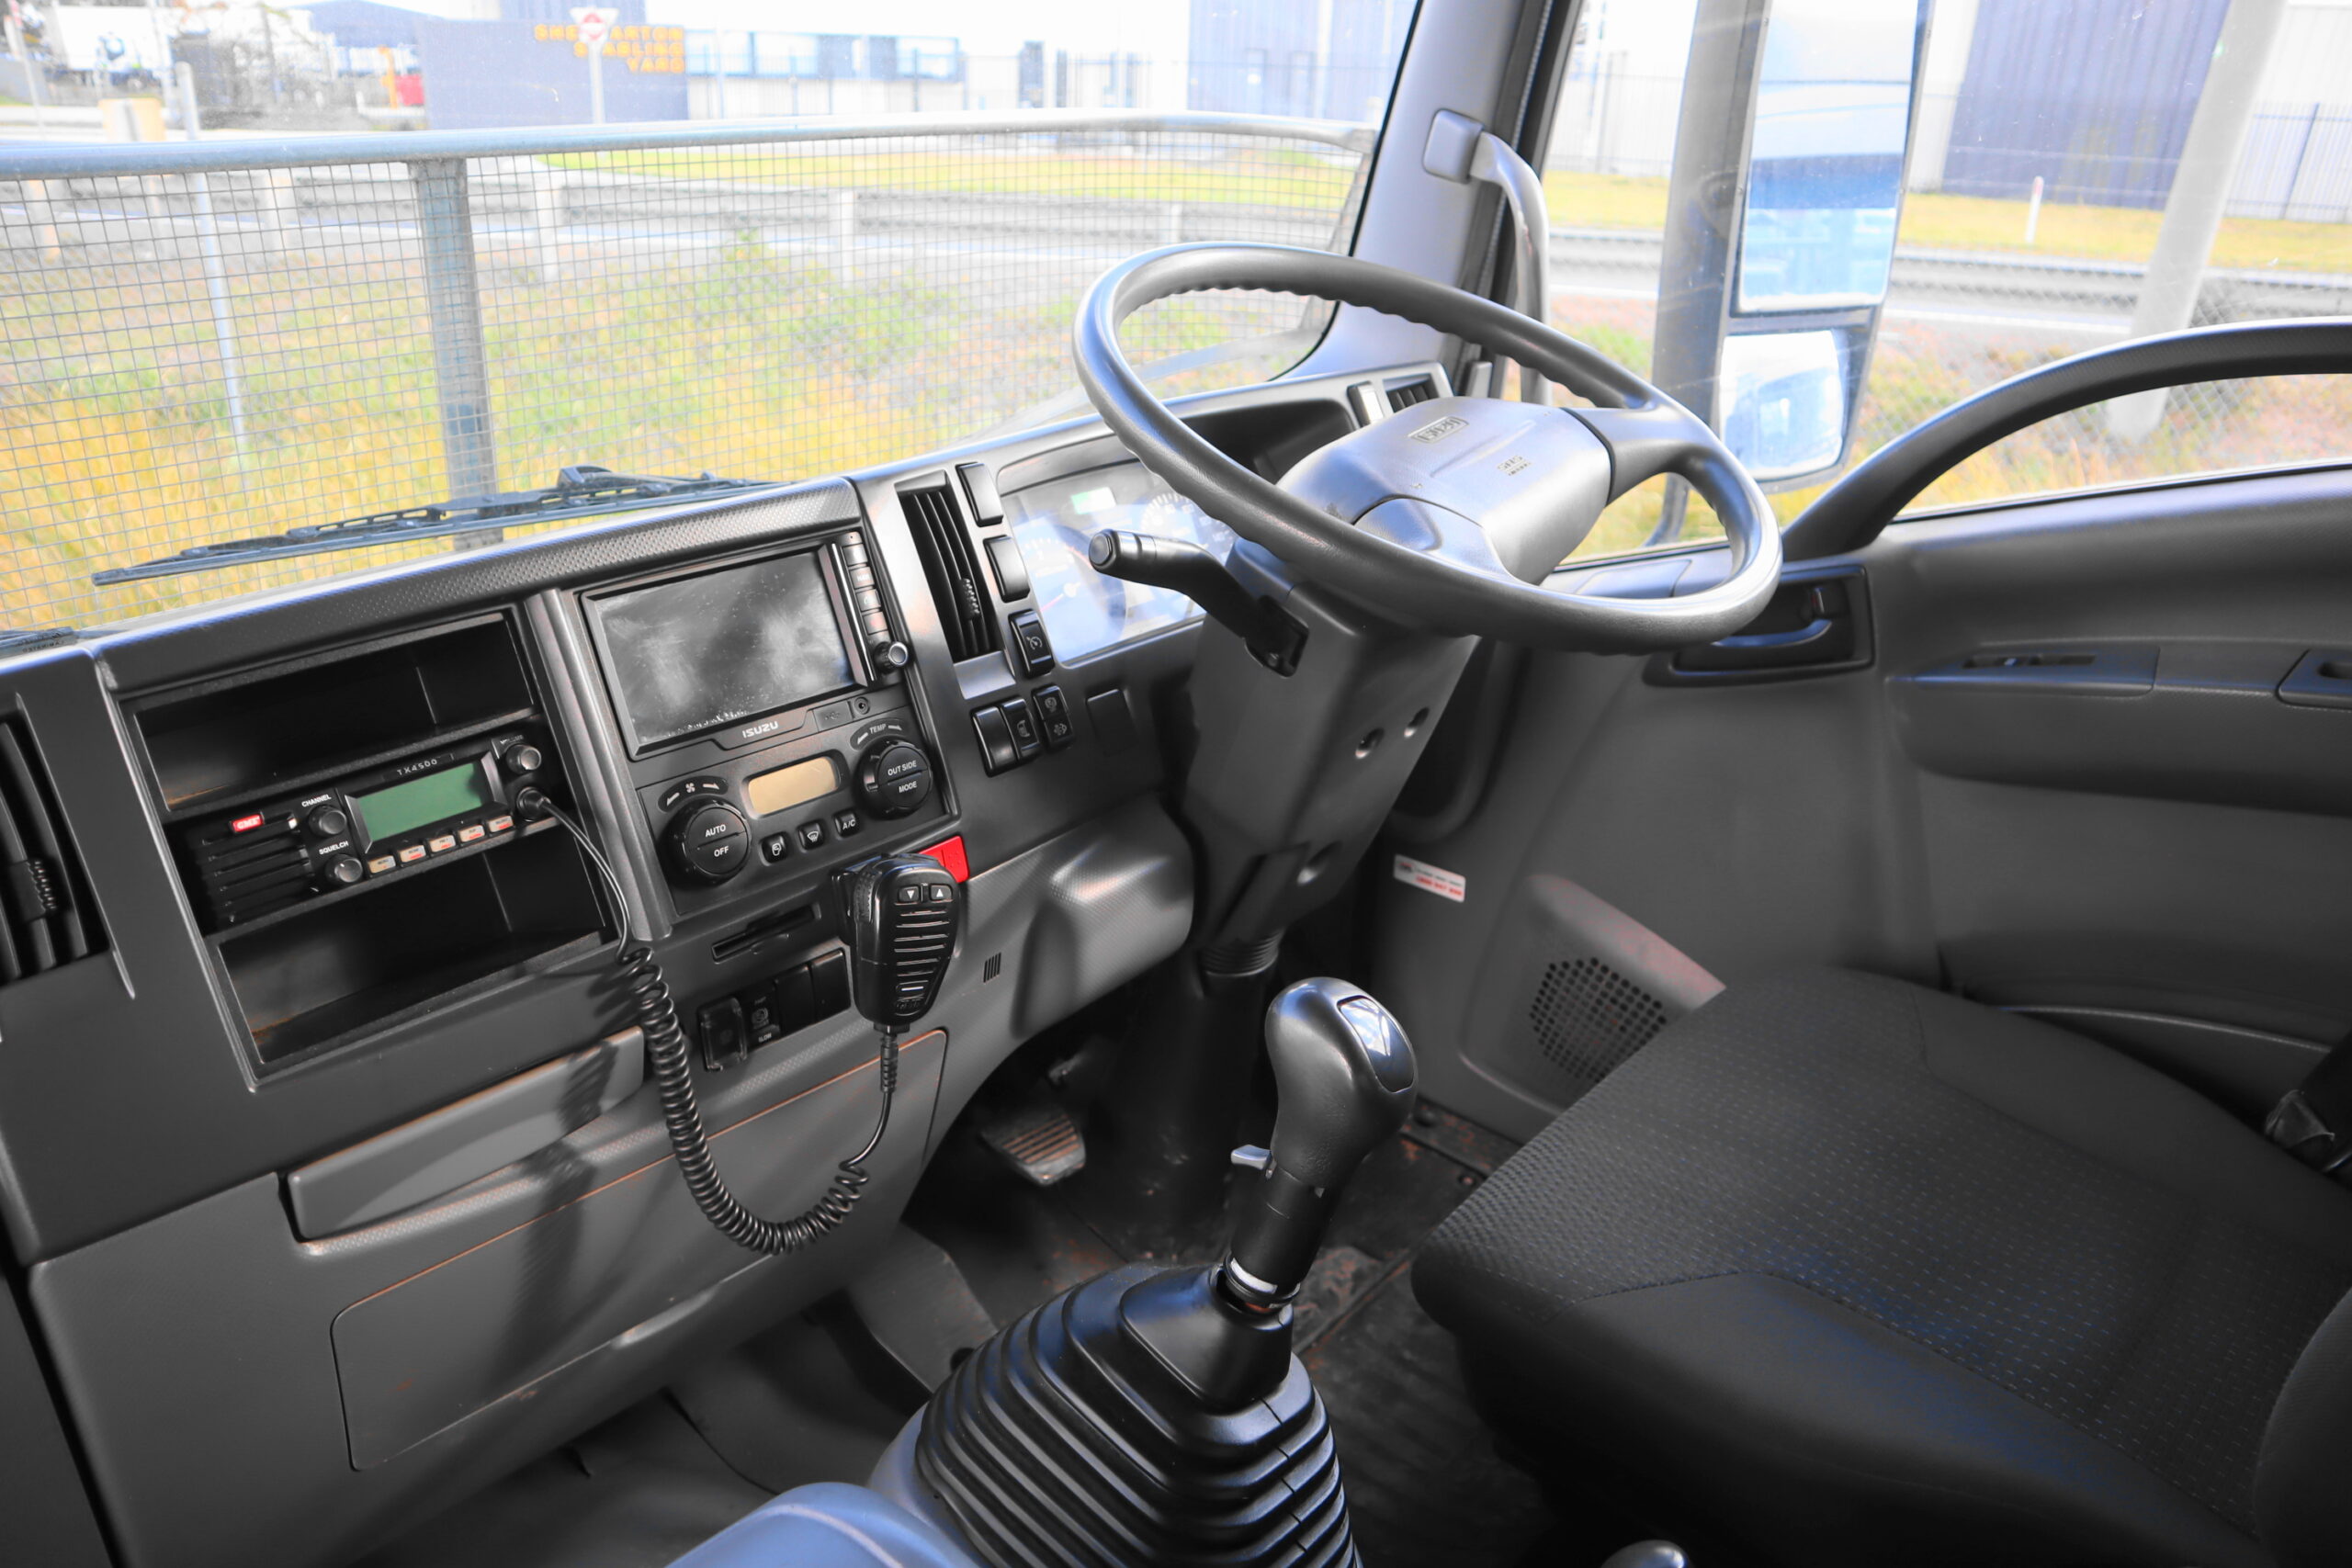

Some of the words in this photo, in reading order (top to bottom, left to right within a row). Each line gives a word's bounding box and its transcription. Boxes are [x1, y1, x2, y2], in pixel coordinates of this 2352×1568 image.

[535, 24, 684, 41] SHEARTON
[573, 41, 684, 57] SABLING
[627, 57, 685, 73] YARD
[741, 720, 779, 739] ISUZU
[869, 723, 887, 734] TEMP
[396, 758, 437, 776] TX4500
[887, 765, 902, 776] OUT
[901, 760, 917, 772] SIDE
[899, 781, 918, 794] MODE
[301, 794, 332, 807] CHANNEL
[705, 824, 727, 838] AUTO
[842, 818, 856, 830] A/C
[319, 840, 349, 855] SQUELCH
[714, 845, 729, 857] OFF
